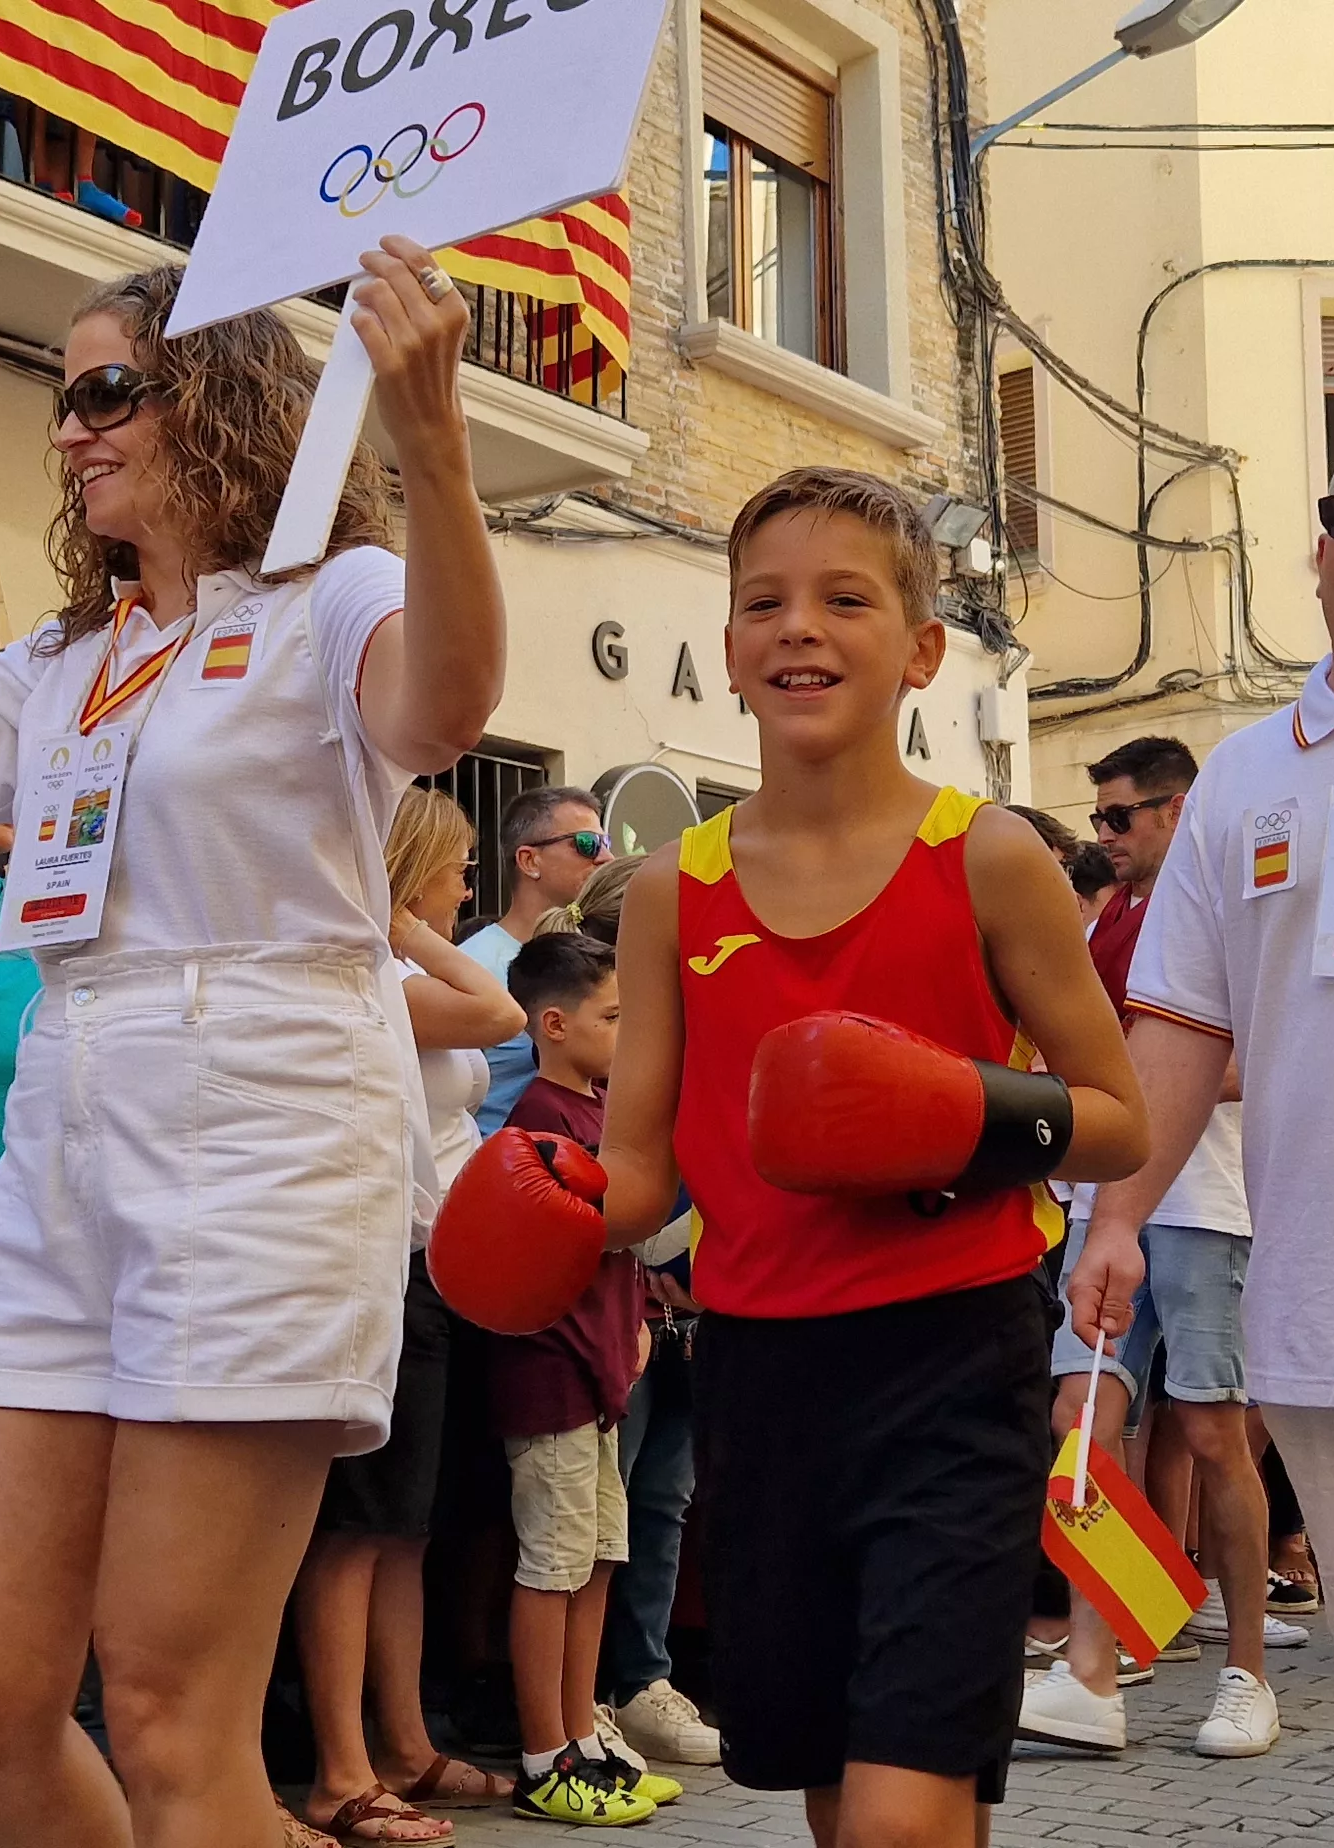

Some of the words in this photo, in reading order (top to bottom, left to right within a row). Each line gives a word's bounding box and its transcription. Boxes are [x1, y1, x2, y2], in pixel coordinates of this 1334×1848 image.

[277, 0, 592, 122] BOXE
[216, 625, 251, 637] ESPAÑA
[46, 879, 71, 890] SPAIN
